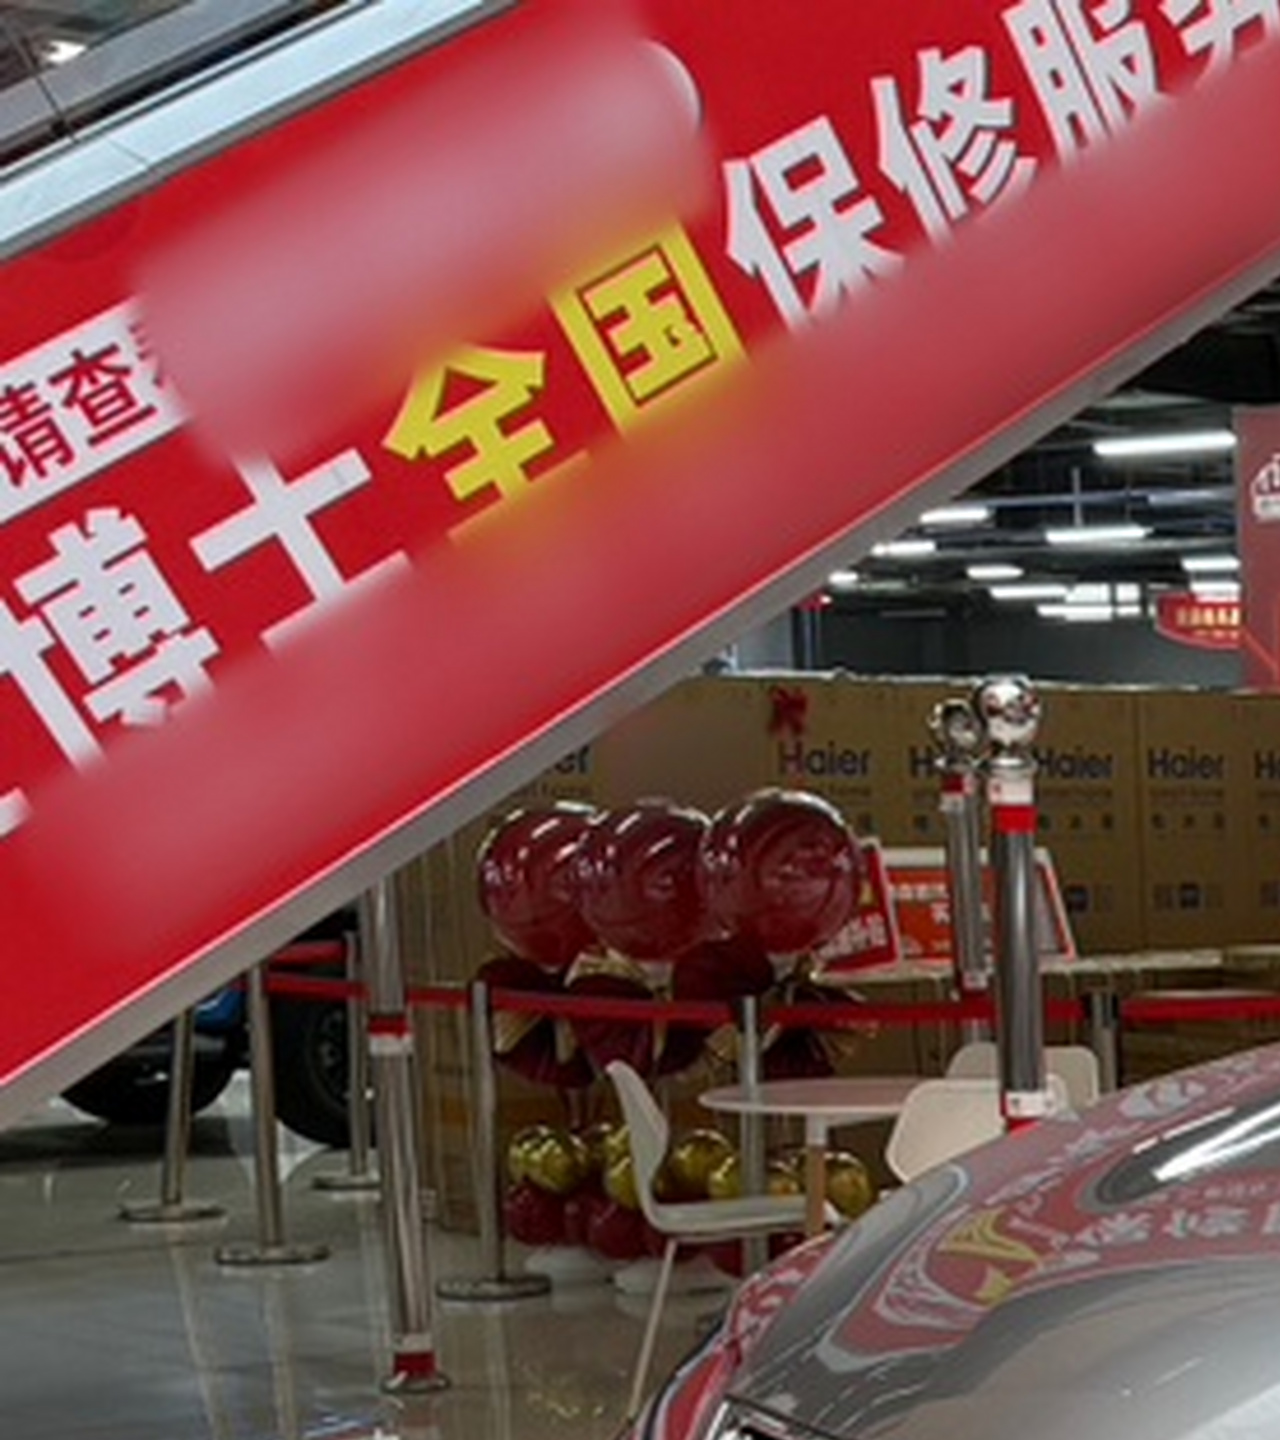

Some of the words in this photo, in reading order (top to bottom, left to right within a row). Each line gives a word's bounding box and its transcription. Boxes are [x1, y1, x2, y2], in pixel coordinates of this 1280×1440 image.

[0, 320, 163, 487] 请查
[776, 740, 871, 777] Haier
[1148, 746, 1225, 779] Haier
